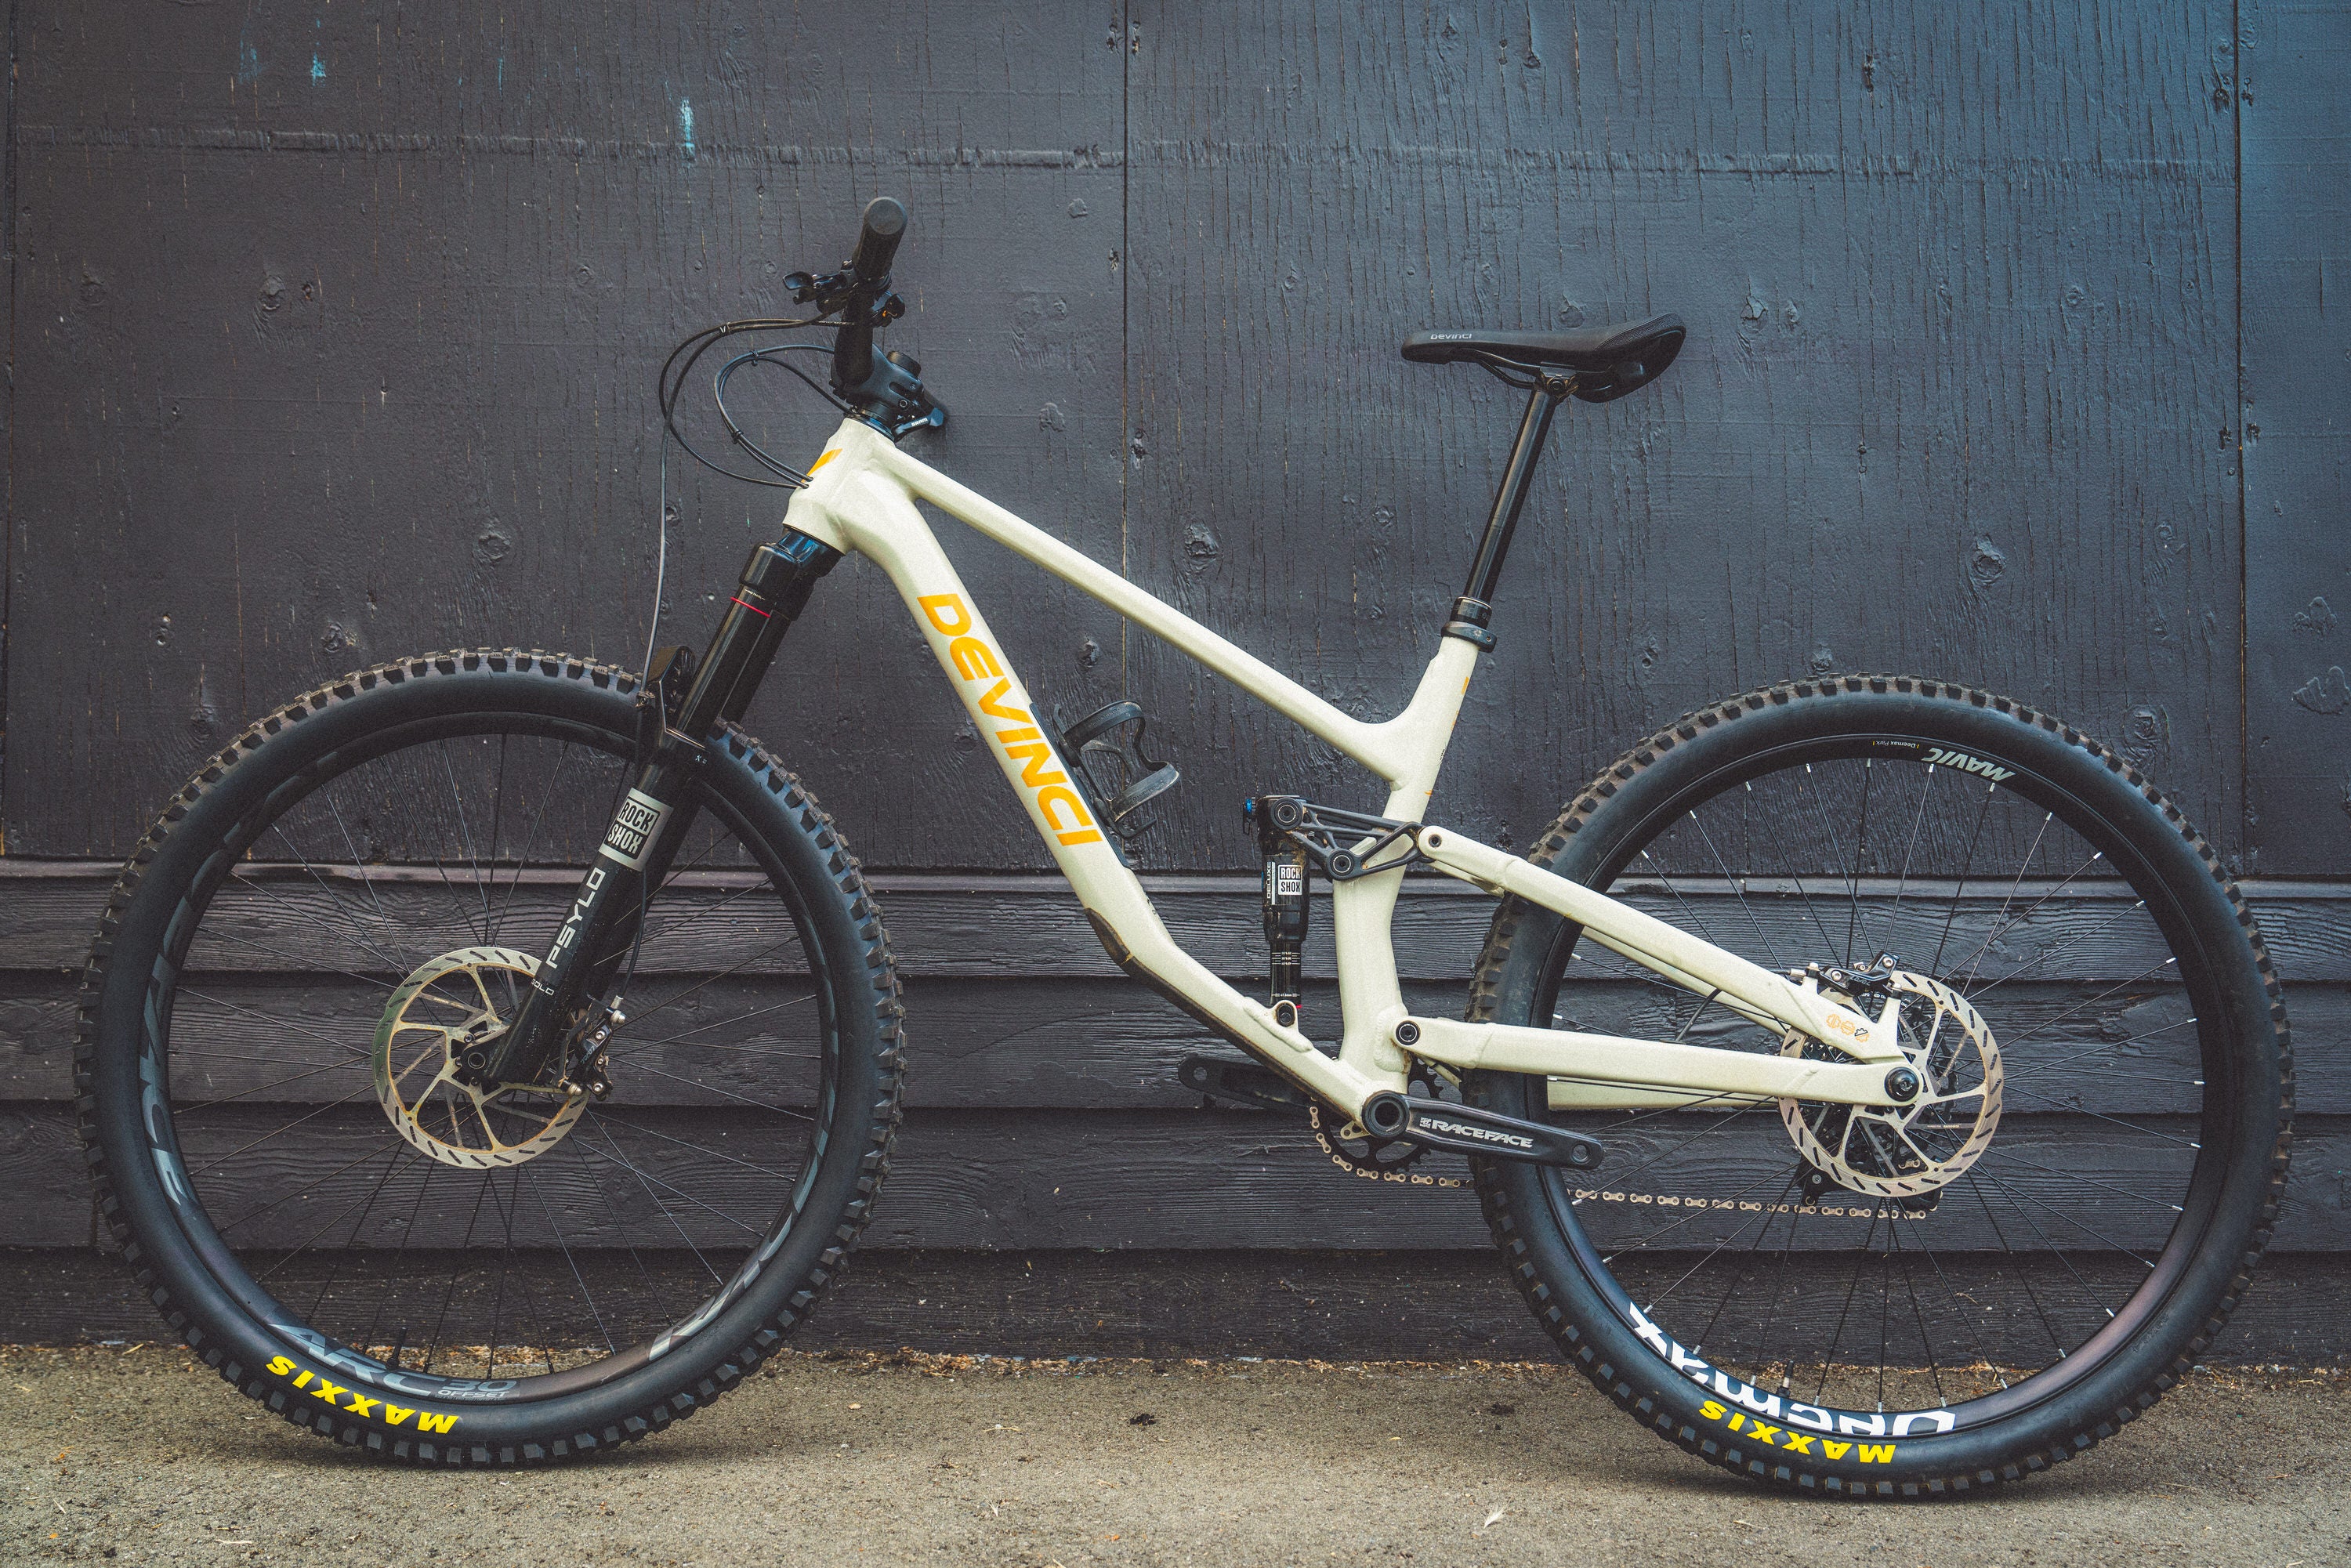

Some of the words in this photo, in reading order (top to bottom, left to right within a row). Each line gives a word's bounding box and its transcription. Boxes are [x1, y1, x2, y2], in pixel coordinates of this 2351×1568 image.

[917, 594, 1103, 846] DEVINCI
[1921, 748, 2016, 781] MAVIC
[618, 802, 655, 832] ROCK
[607, 824, 643, 854] SHOX
[1280, 867, 1301, 879] ROCK
[1281, 882, 1301, 893] SHOX
[545, 867, 607, 969] PSYLO
[1431, 1119, 1534, 1148] RACEFACE
[266, 1355, 458, 1434] MAXXIS
[442, 1379, 517, 1392] 30
[1699, 1400, 1896, 1464] MAXXIS
